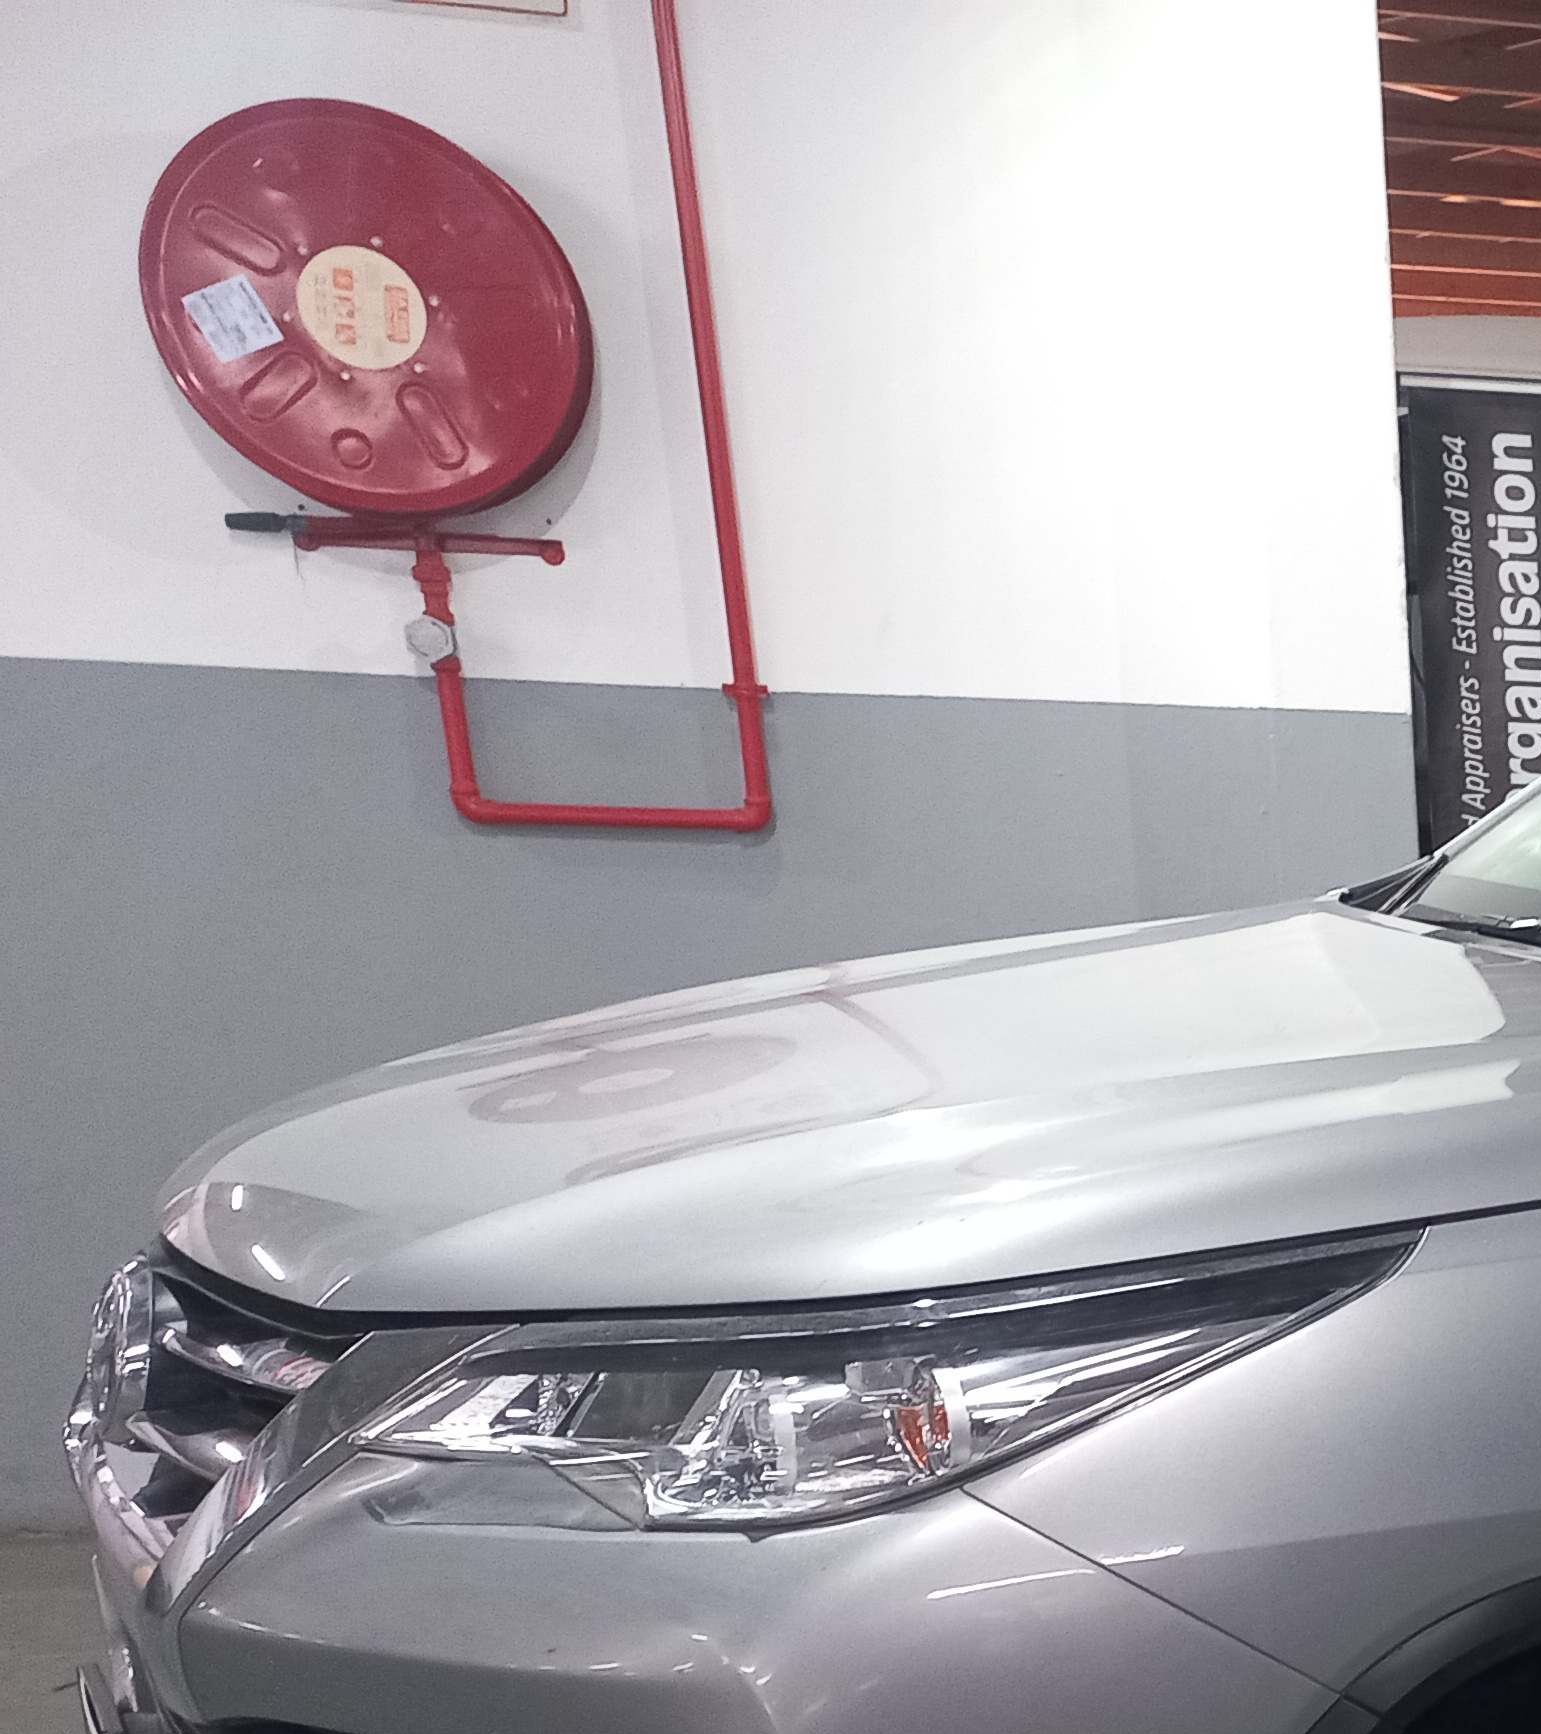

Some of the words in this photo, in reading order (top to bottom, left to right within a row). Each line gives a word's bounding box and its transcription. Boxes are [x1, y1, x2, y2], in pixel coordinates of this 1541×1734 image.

[1441, 434, 1470, 498] 1964
[1442, 505, 1477, 654] Established
[1455, 675, 1491, 811] Appraisers
